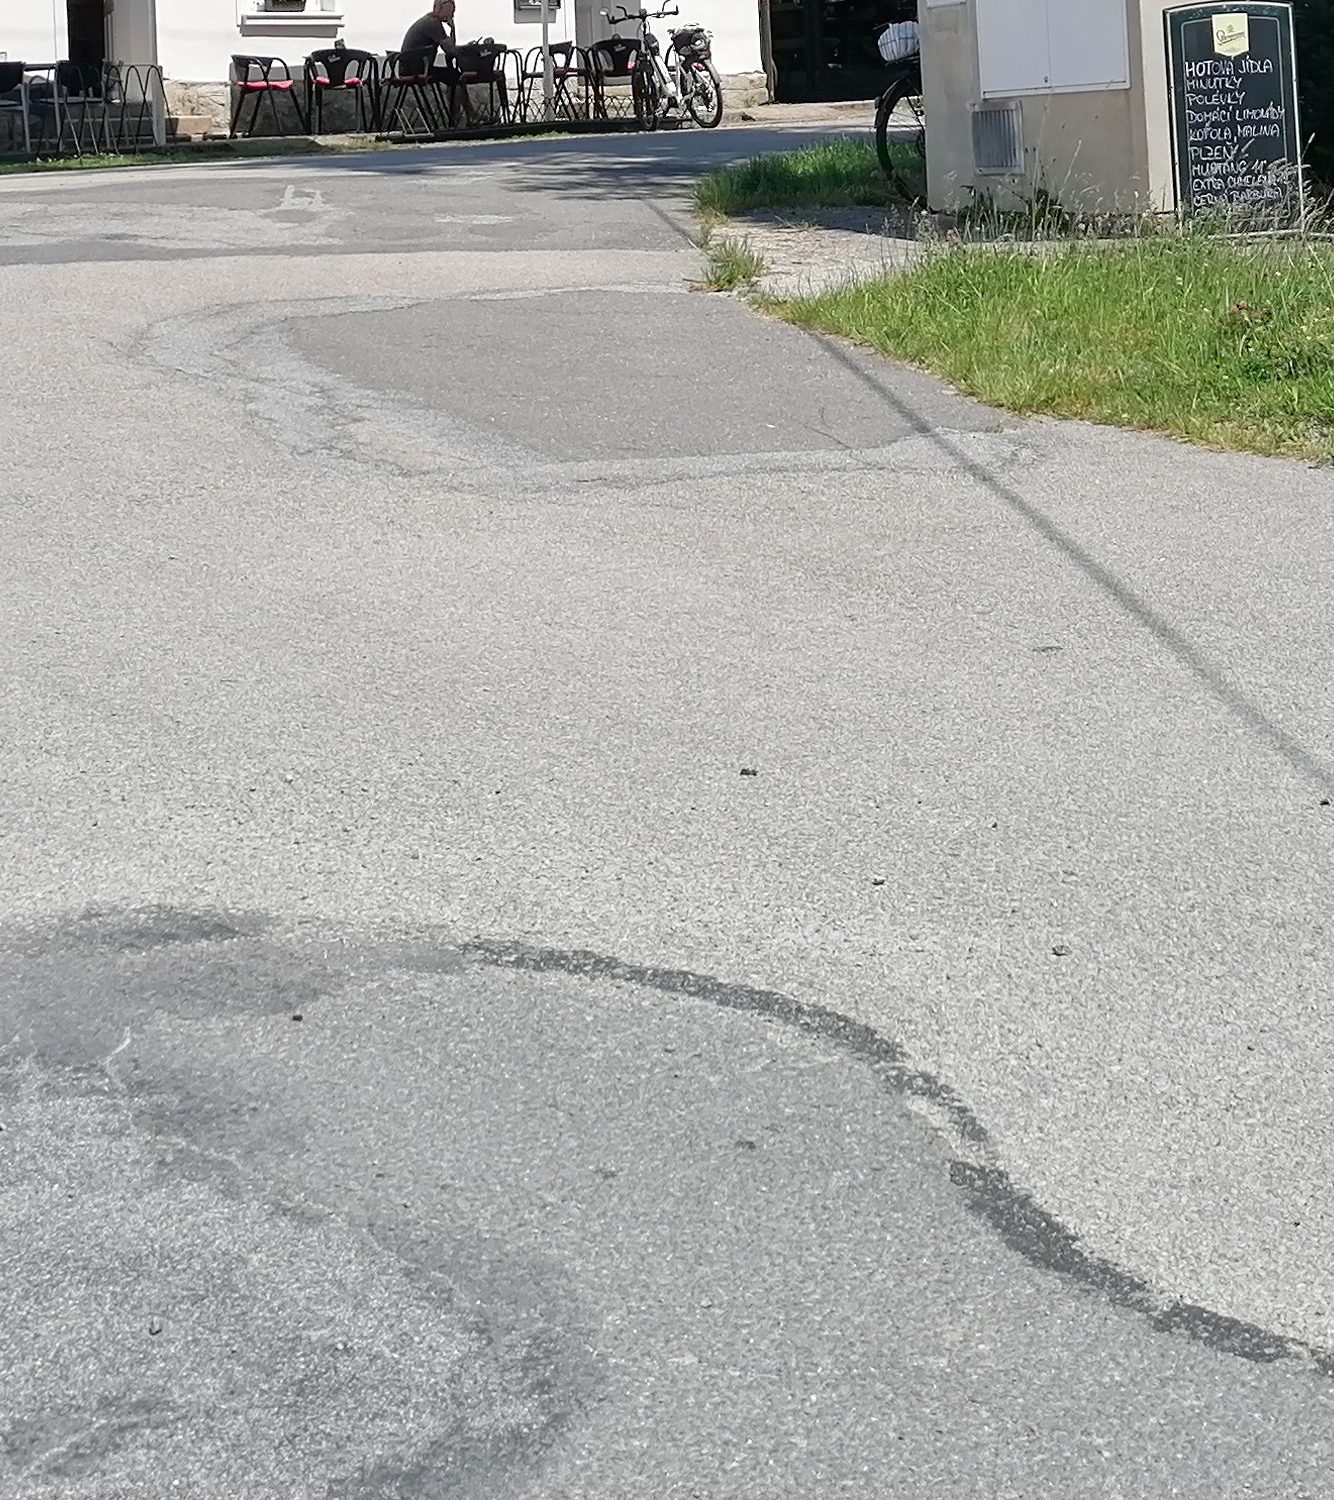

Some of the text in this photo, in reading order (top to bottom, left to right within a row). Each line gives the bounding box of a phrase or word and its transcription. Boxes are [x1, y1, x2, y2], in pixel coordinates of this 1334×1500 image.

[1238, 55, 1273, 74] JÍDLA
[1187, 77, 1242, 90] MINUTKY
[1186, 90, 1246, 106] POLÉVKY
[1186, 106, 1233, 123] DOMÁCÍ
[1237, 123, 1280, 138] MALINA
[1192, 161, 1247, 176] MUSTANG
